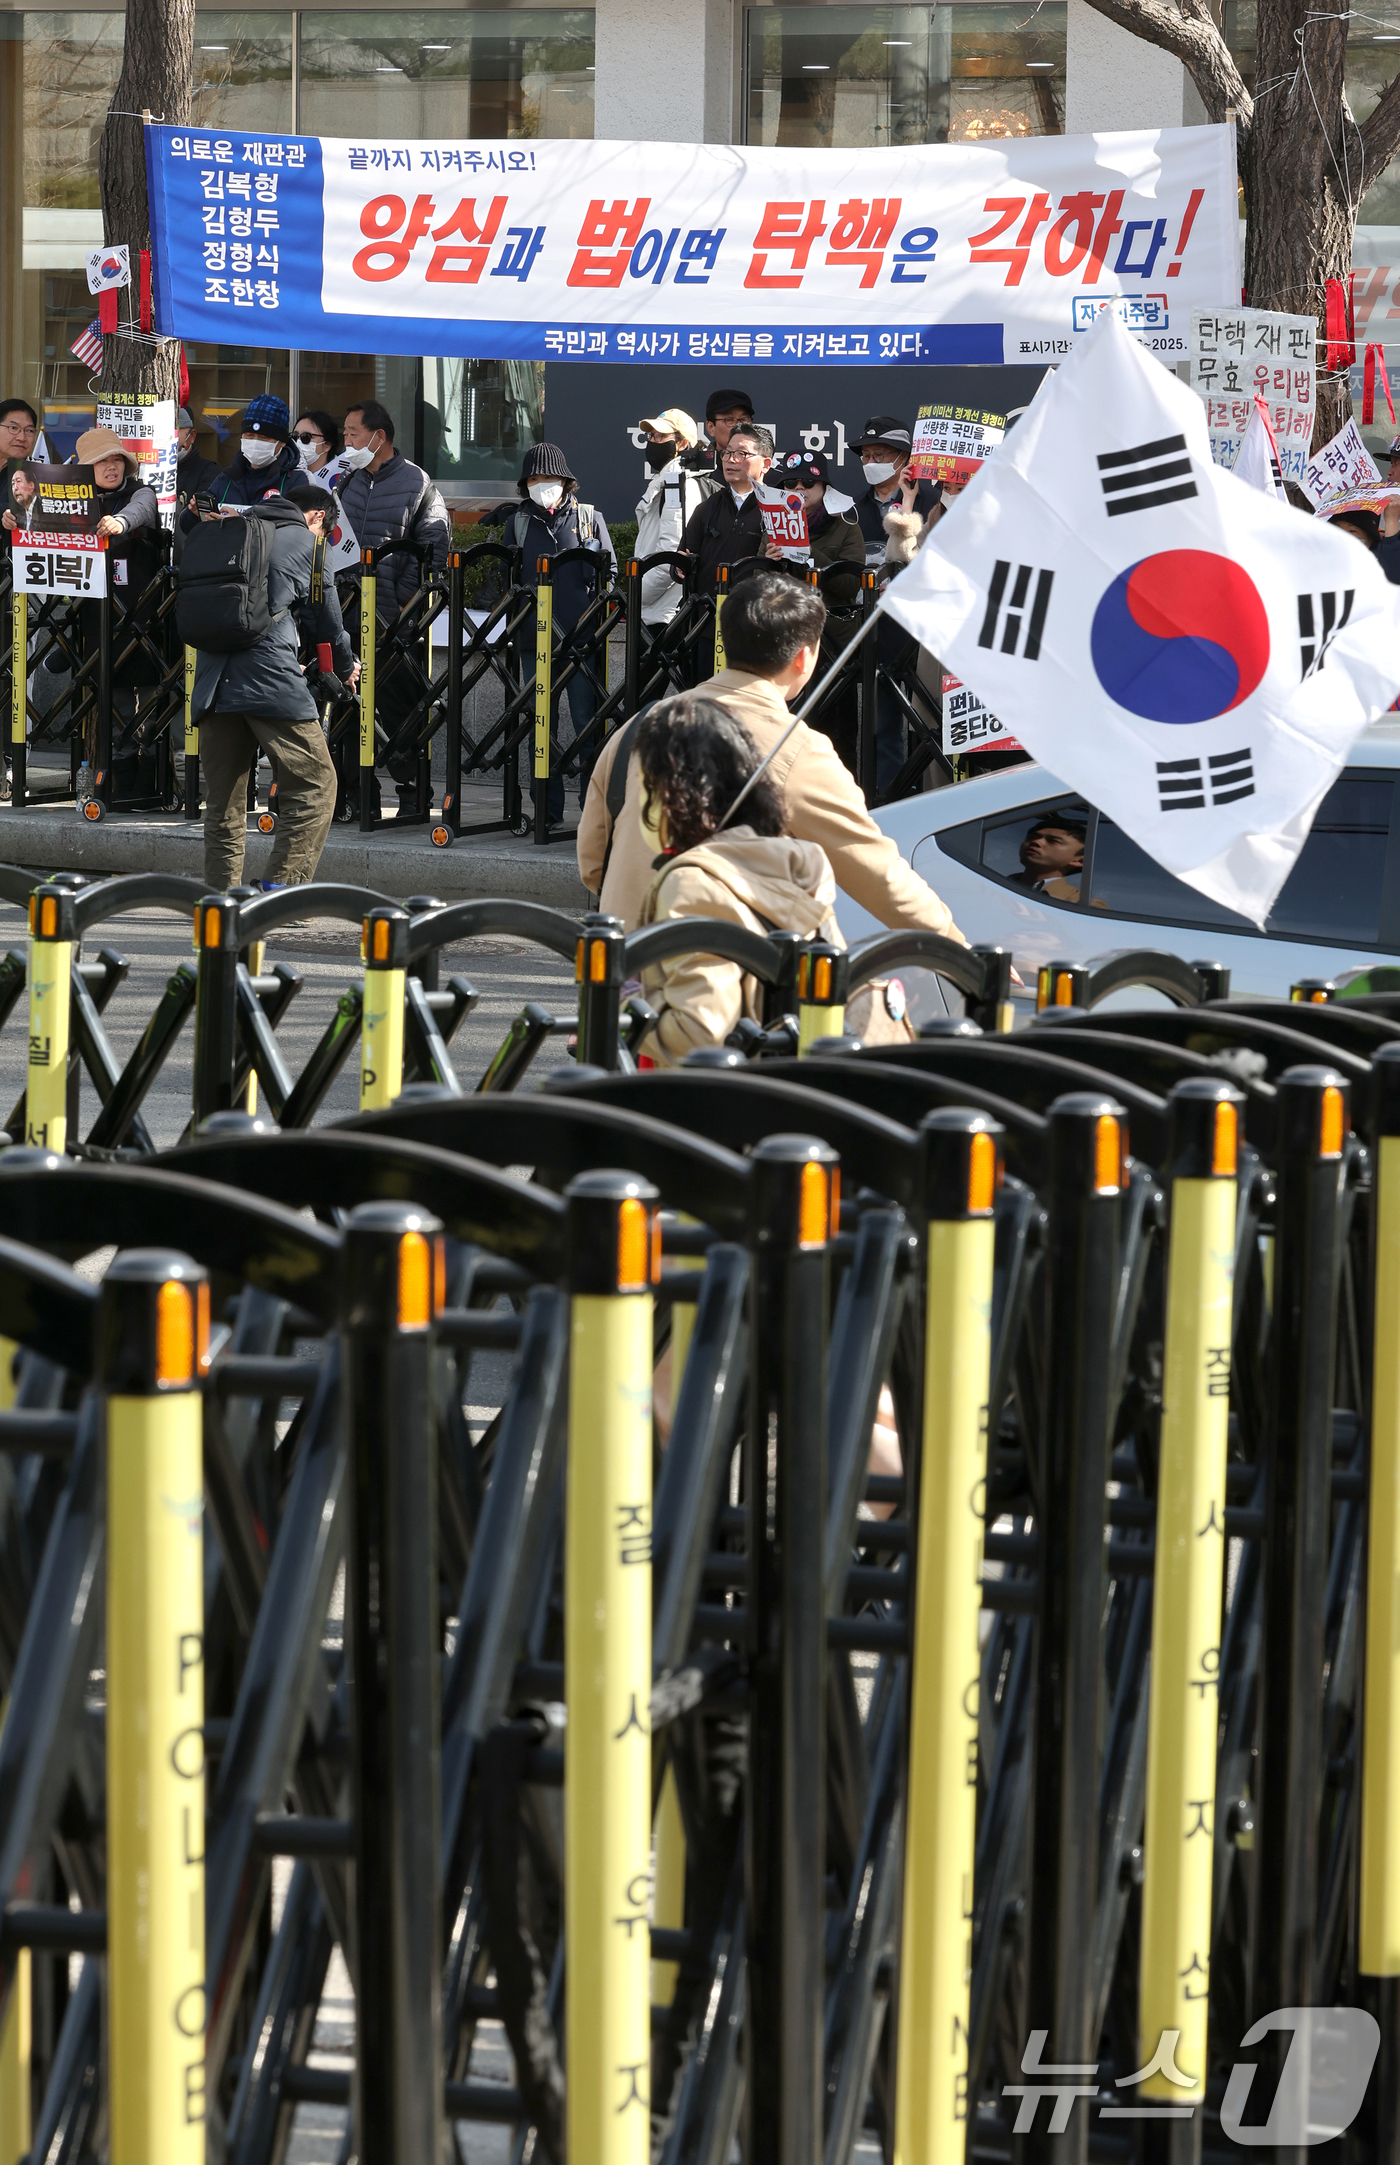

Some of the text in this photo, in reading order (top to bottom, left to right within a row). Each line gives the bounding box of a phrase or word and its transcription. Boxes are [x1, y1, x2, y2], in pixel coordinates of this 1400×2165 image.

[170, 136, 307, 168] 의로운 재판관
[348, 147, 536, 173] 끝까지 지켜주시오!
[200, 169, 280, 203] 김복형
[201, 205, 280, 238] 김형두
[352, 188, 1206, 289] 양심과 법이면 탄핵은 각하다!
[202, 241, 280, 275] 정형식
[204, 277, 280, 310] 조한창
[544, 329, 930, 358] 국민과 역사가 당신들을 지켜보고 있다.
[1018, 339, 1073, 355] 표시기간:
[1198, 318, 1246, 355] 탄핵
[1254, 324, 1312, 360] 재판
[1198, 358, 1311, 404] 무효 우리법
[114, 393, 135, 406] 정계선
[114, 408, 144, 421] 국민을
[932, 405, 954, 419] 이미선
[955, 406, 980, 422] 정계선
[981, 411, 1006, 429] 정정미
[139, 424, 155, 438] 말라
[922, 420, 985, 440] 선량한 국민을
[949, 440, 975, 456] 내몰지
[937, 456, 957, 469] 끝에
[38, 482, 94, 499] 대통령이
[41, 498, 89, 516] 옳았다!
[18, 529, 99, 549] 자유민주주의
[25, 552, 94, 591] 회복!
[361, 611, 370, 684] POLICE
